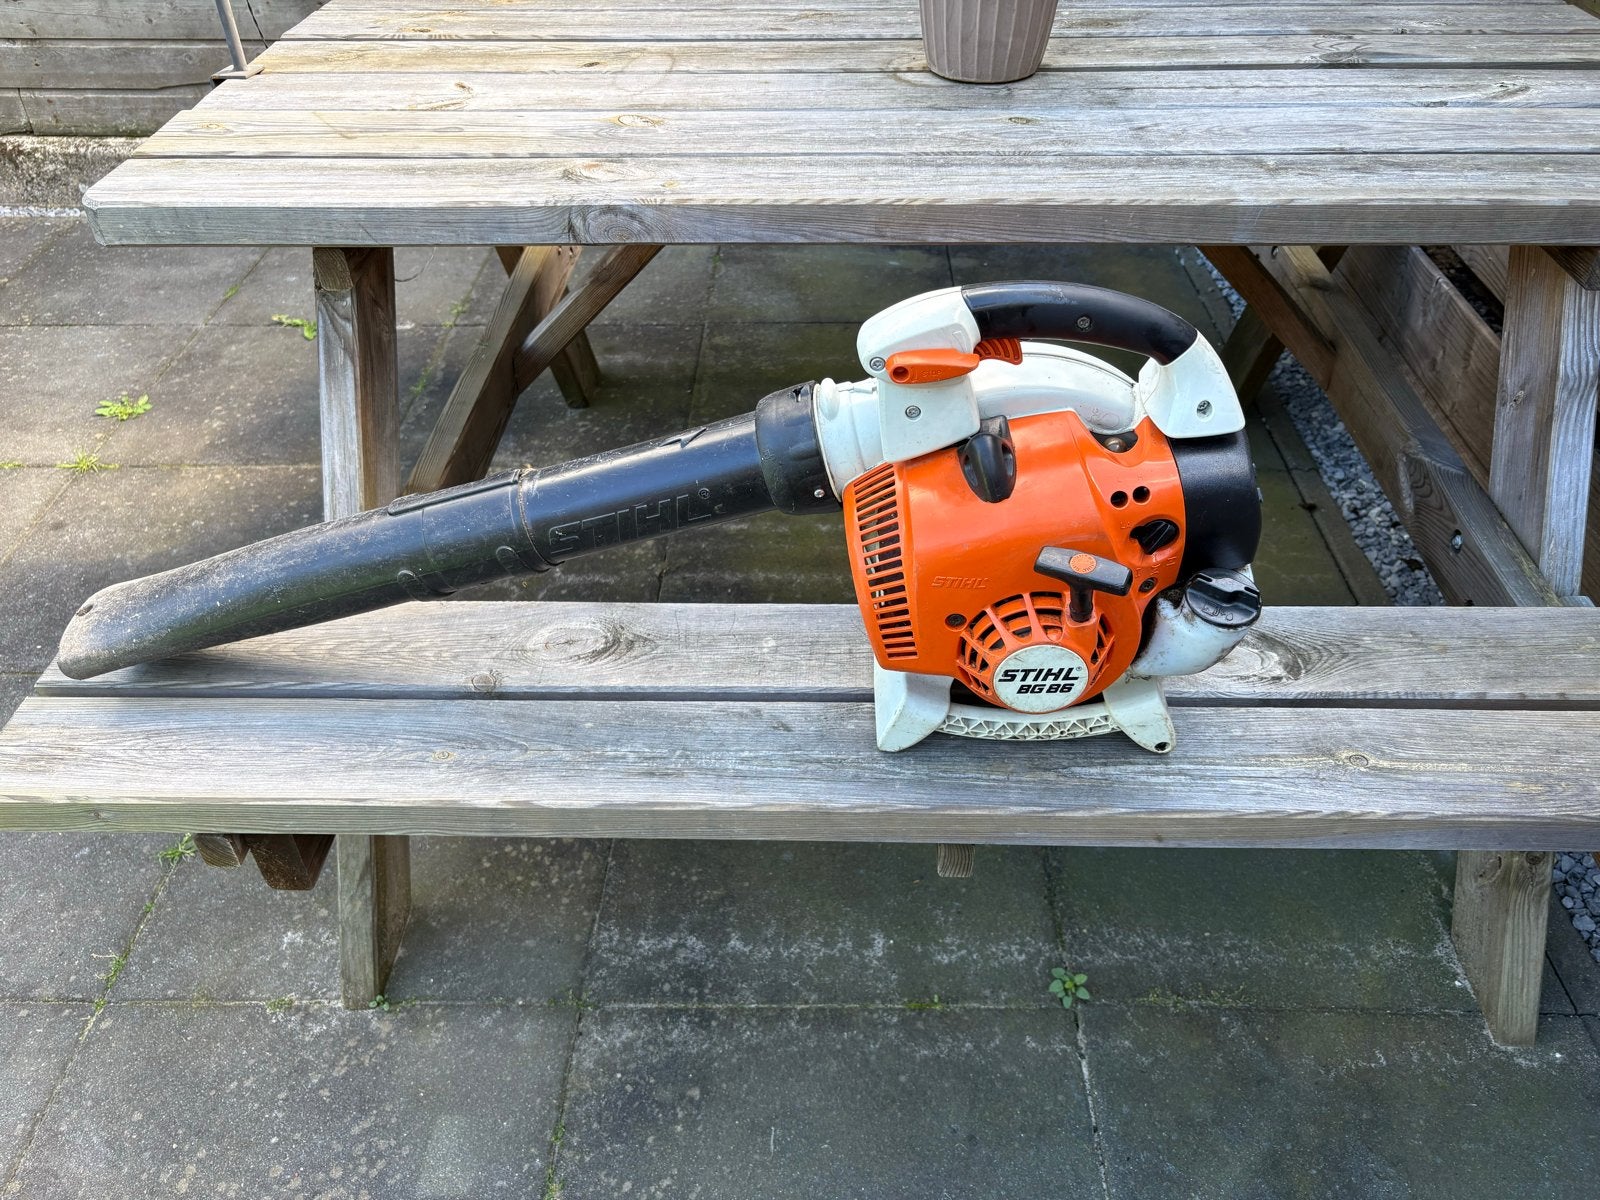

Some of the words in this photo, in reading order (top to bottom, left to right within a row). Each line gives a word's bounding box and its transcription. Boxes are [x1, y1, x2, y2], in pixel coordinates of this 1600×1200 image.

[931, 576, 989, 589] STIHL
[1016, 684, 1046, 694] BG
[1045, 683, 1075, 694] 86
